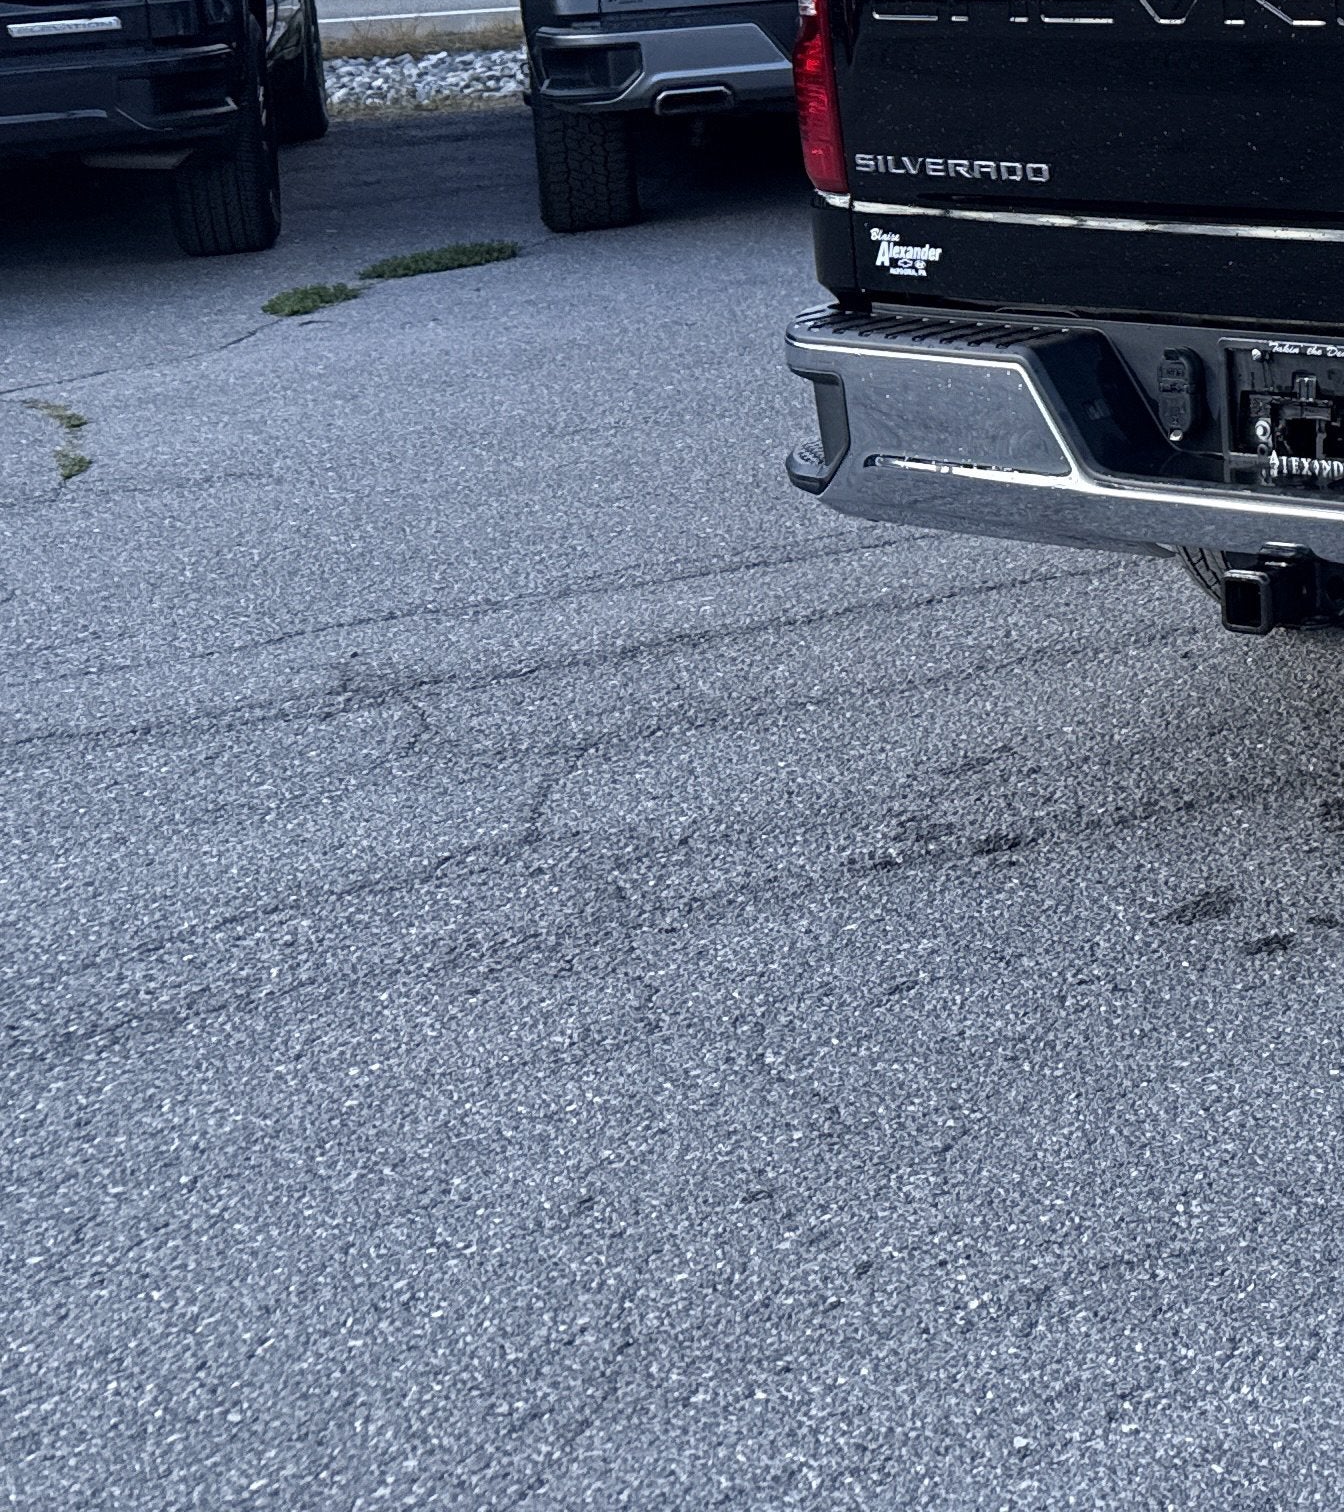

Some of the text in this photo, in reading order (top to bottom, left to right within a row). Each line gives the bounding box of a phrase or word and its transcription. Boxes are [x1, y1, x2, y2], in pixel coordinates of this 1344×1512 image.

[855, 153, 1053, 183] SILVERADO
[875, 241, 943, 267] Alexander
[1306, 346, 1323, 355] the
